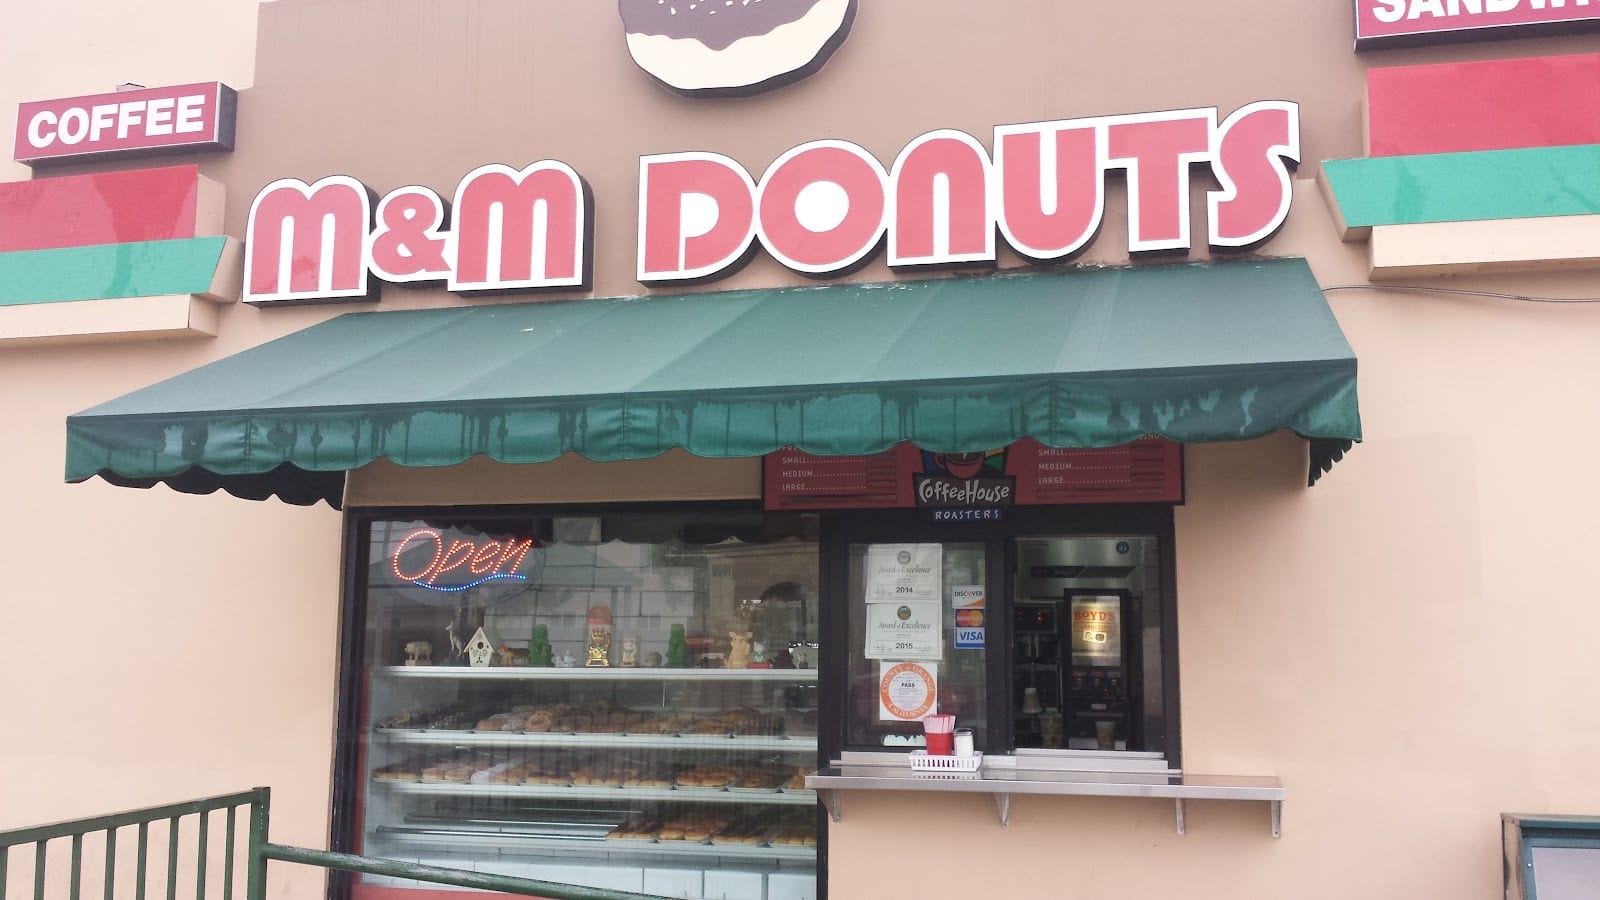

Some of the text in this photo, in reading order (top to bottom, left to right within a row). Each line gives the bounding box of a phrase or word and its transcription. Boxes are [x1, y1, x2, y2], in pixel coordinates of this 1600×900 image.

[27, 94, 206, 149] COFFEE
[242, 101, 1300, 302] M&M DONUTS
[919, 479, 1010, 505] CoffeeHouse
[935, 509, 999, 520] ROASTERS
[392, 529, 533, 585] Open
[896, 586, 913, 594] 2014
[959, 631, 984, 641] VISA
[895, 642, 913, 650] 2015
